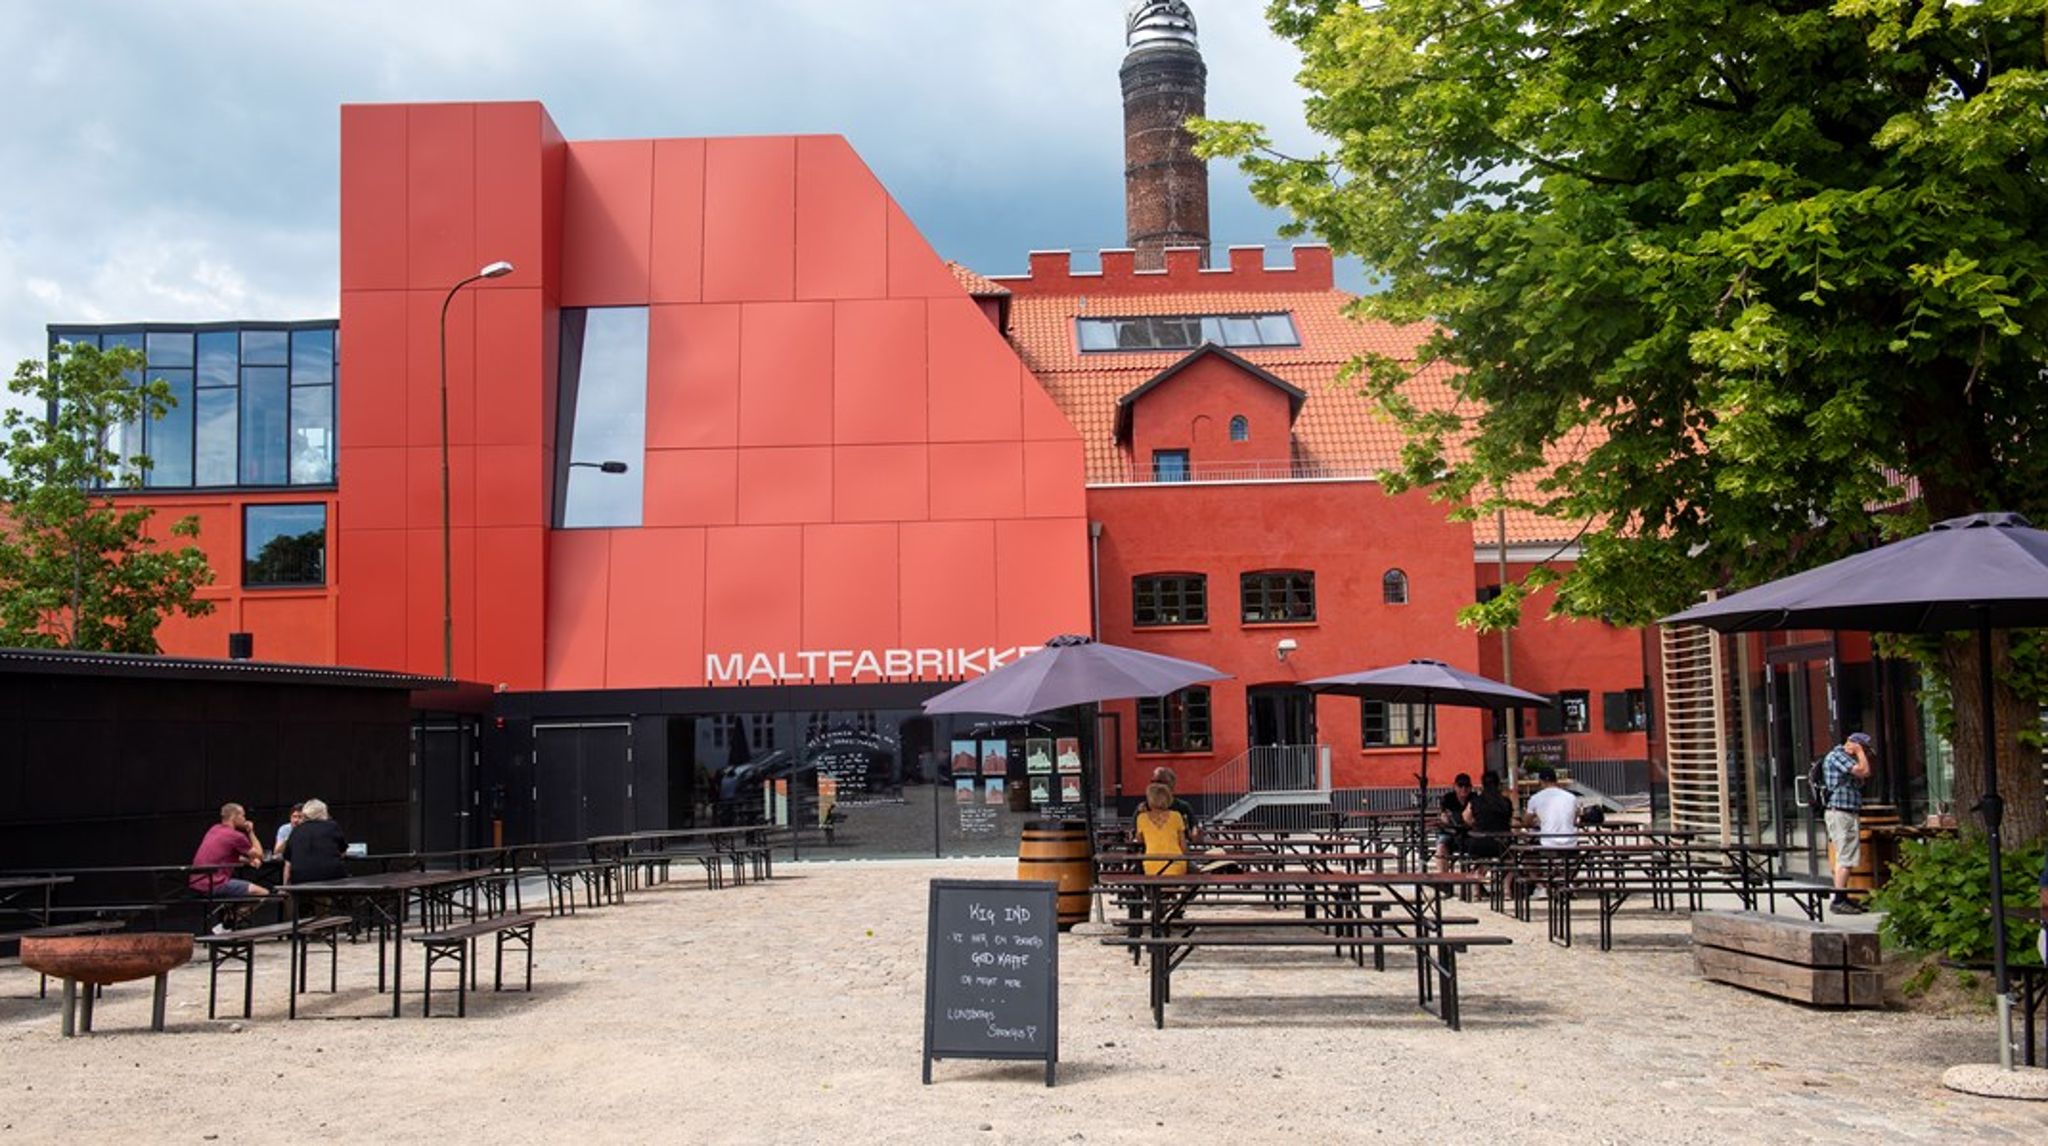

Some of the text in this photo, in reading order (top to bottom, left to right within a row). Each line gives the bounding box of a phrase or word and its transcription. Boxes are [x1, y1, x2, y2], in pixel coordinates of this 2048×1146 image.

[969, 902, 1031, 925] KIG IND
[971, 951, 995, 967] GOD
